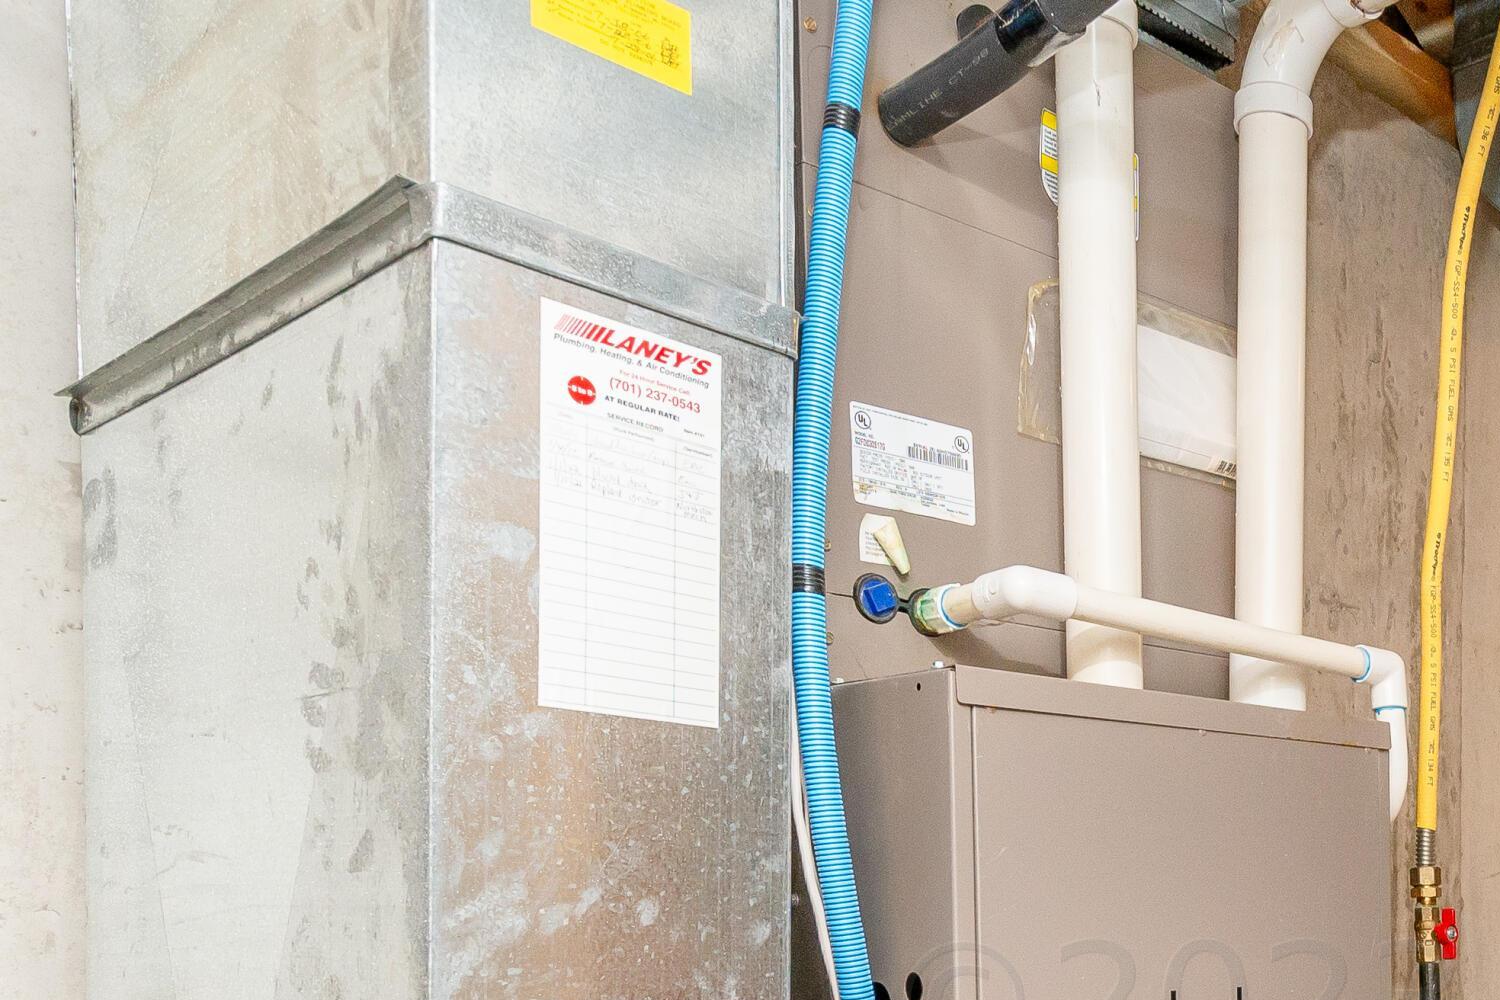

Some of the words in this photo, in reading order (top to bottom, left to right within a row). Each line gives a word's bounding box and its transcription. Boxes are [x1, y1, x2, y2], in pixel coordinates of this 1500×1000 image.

[600, 329, 712, 375] LANEY'S
[659, 366, 710, 389] Conditioning
[609, 377, 642, 397] (701)
[645, 388, 701, 413] 237-0543
[617, 398, 656, 415] REGULAR
[658, 410, 680, 422] RATE!
